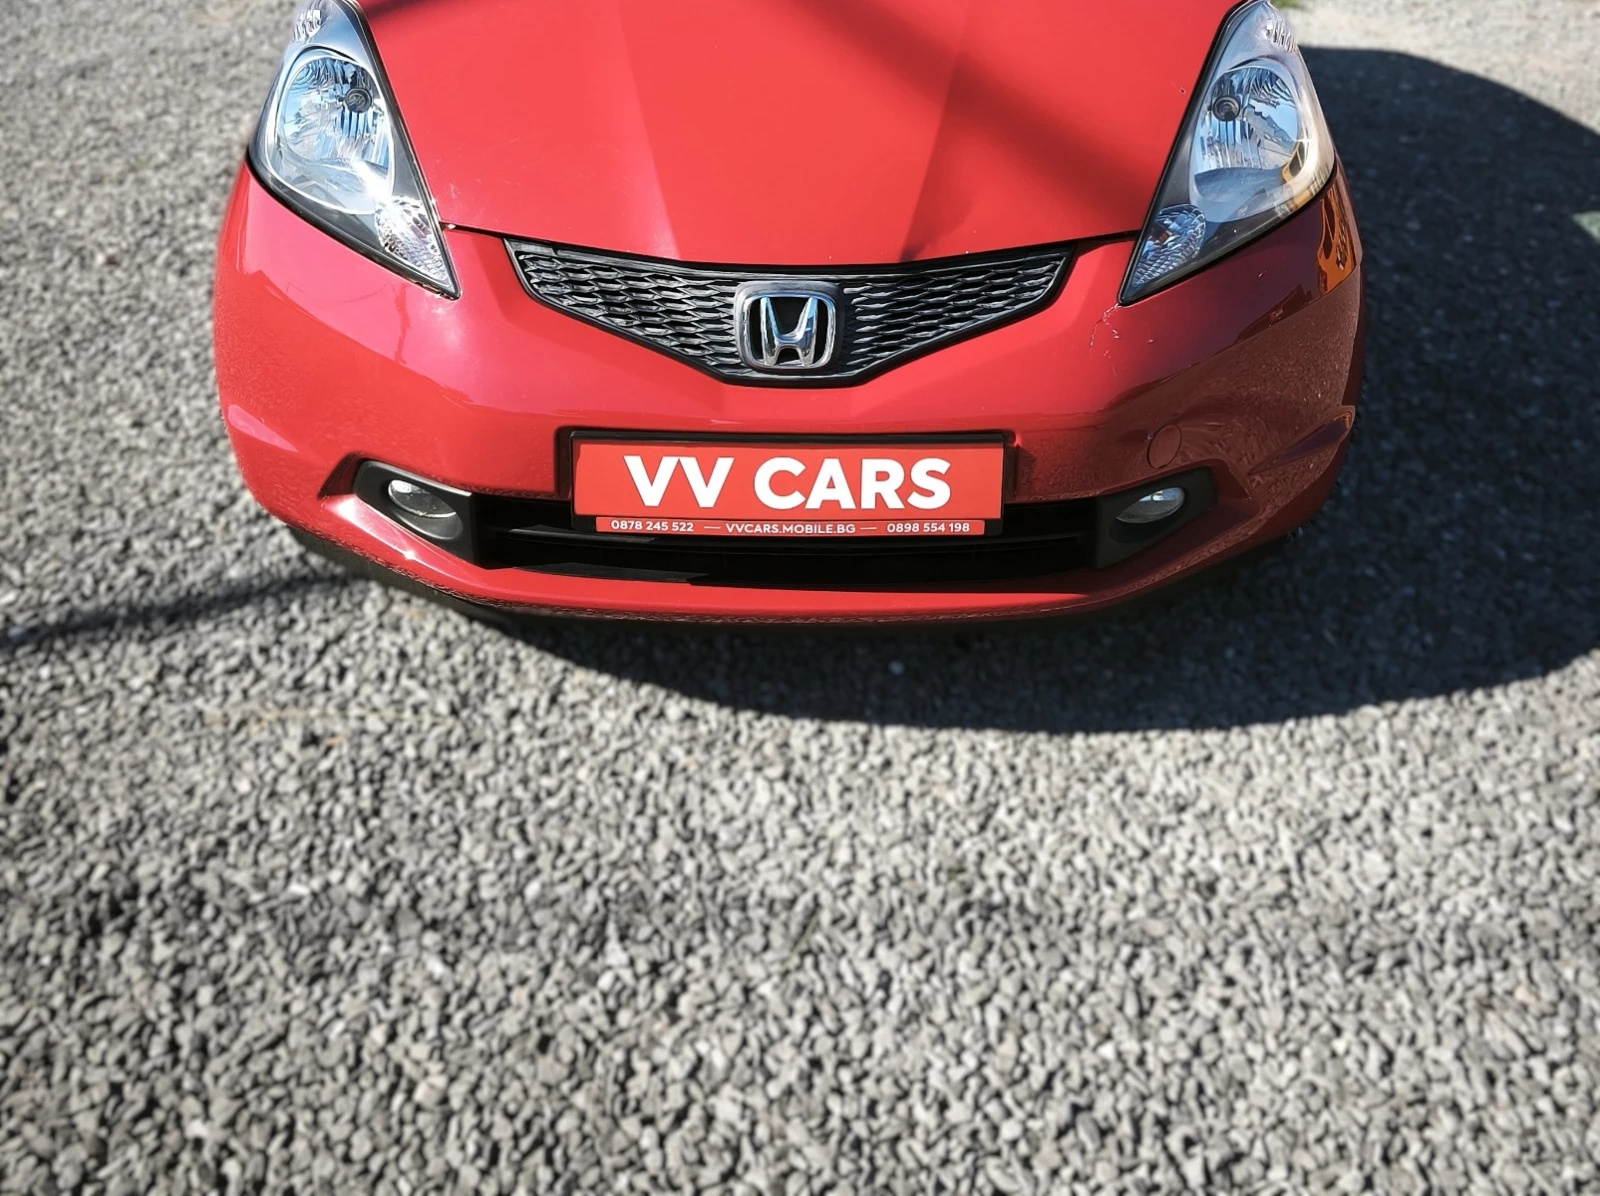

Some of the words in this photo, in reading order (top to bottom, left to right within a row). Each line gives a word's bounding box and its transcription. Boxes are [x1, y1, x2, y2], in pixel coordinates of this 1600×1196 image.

[623, 455, 735, 508] VV
[754, 456, 951, 510] CARS
[610, 519, 643, 531] 0878
[645, 520, 669, 532] 245
[671, 521, 694, 532] 522
[725, 522, 856, 535] VVCARS.MOBILE.BG
[887, 522, 920, 533] 0898
[922, 522, 946, 533] 554
[948, 522, 970, 533] 198
